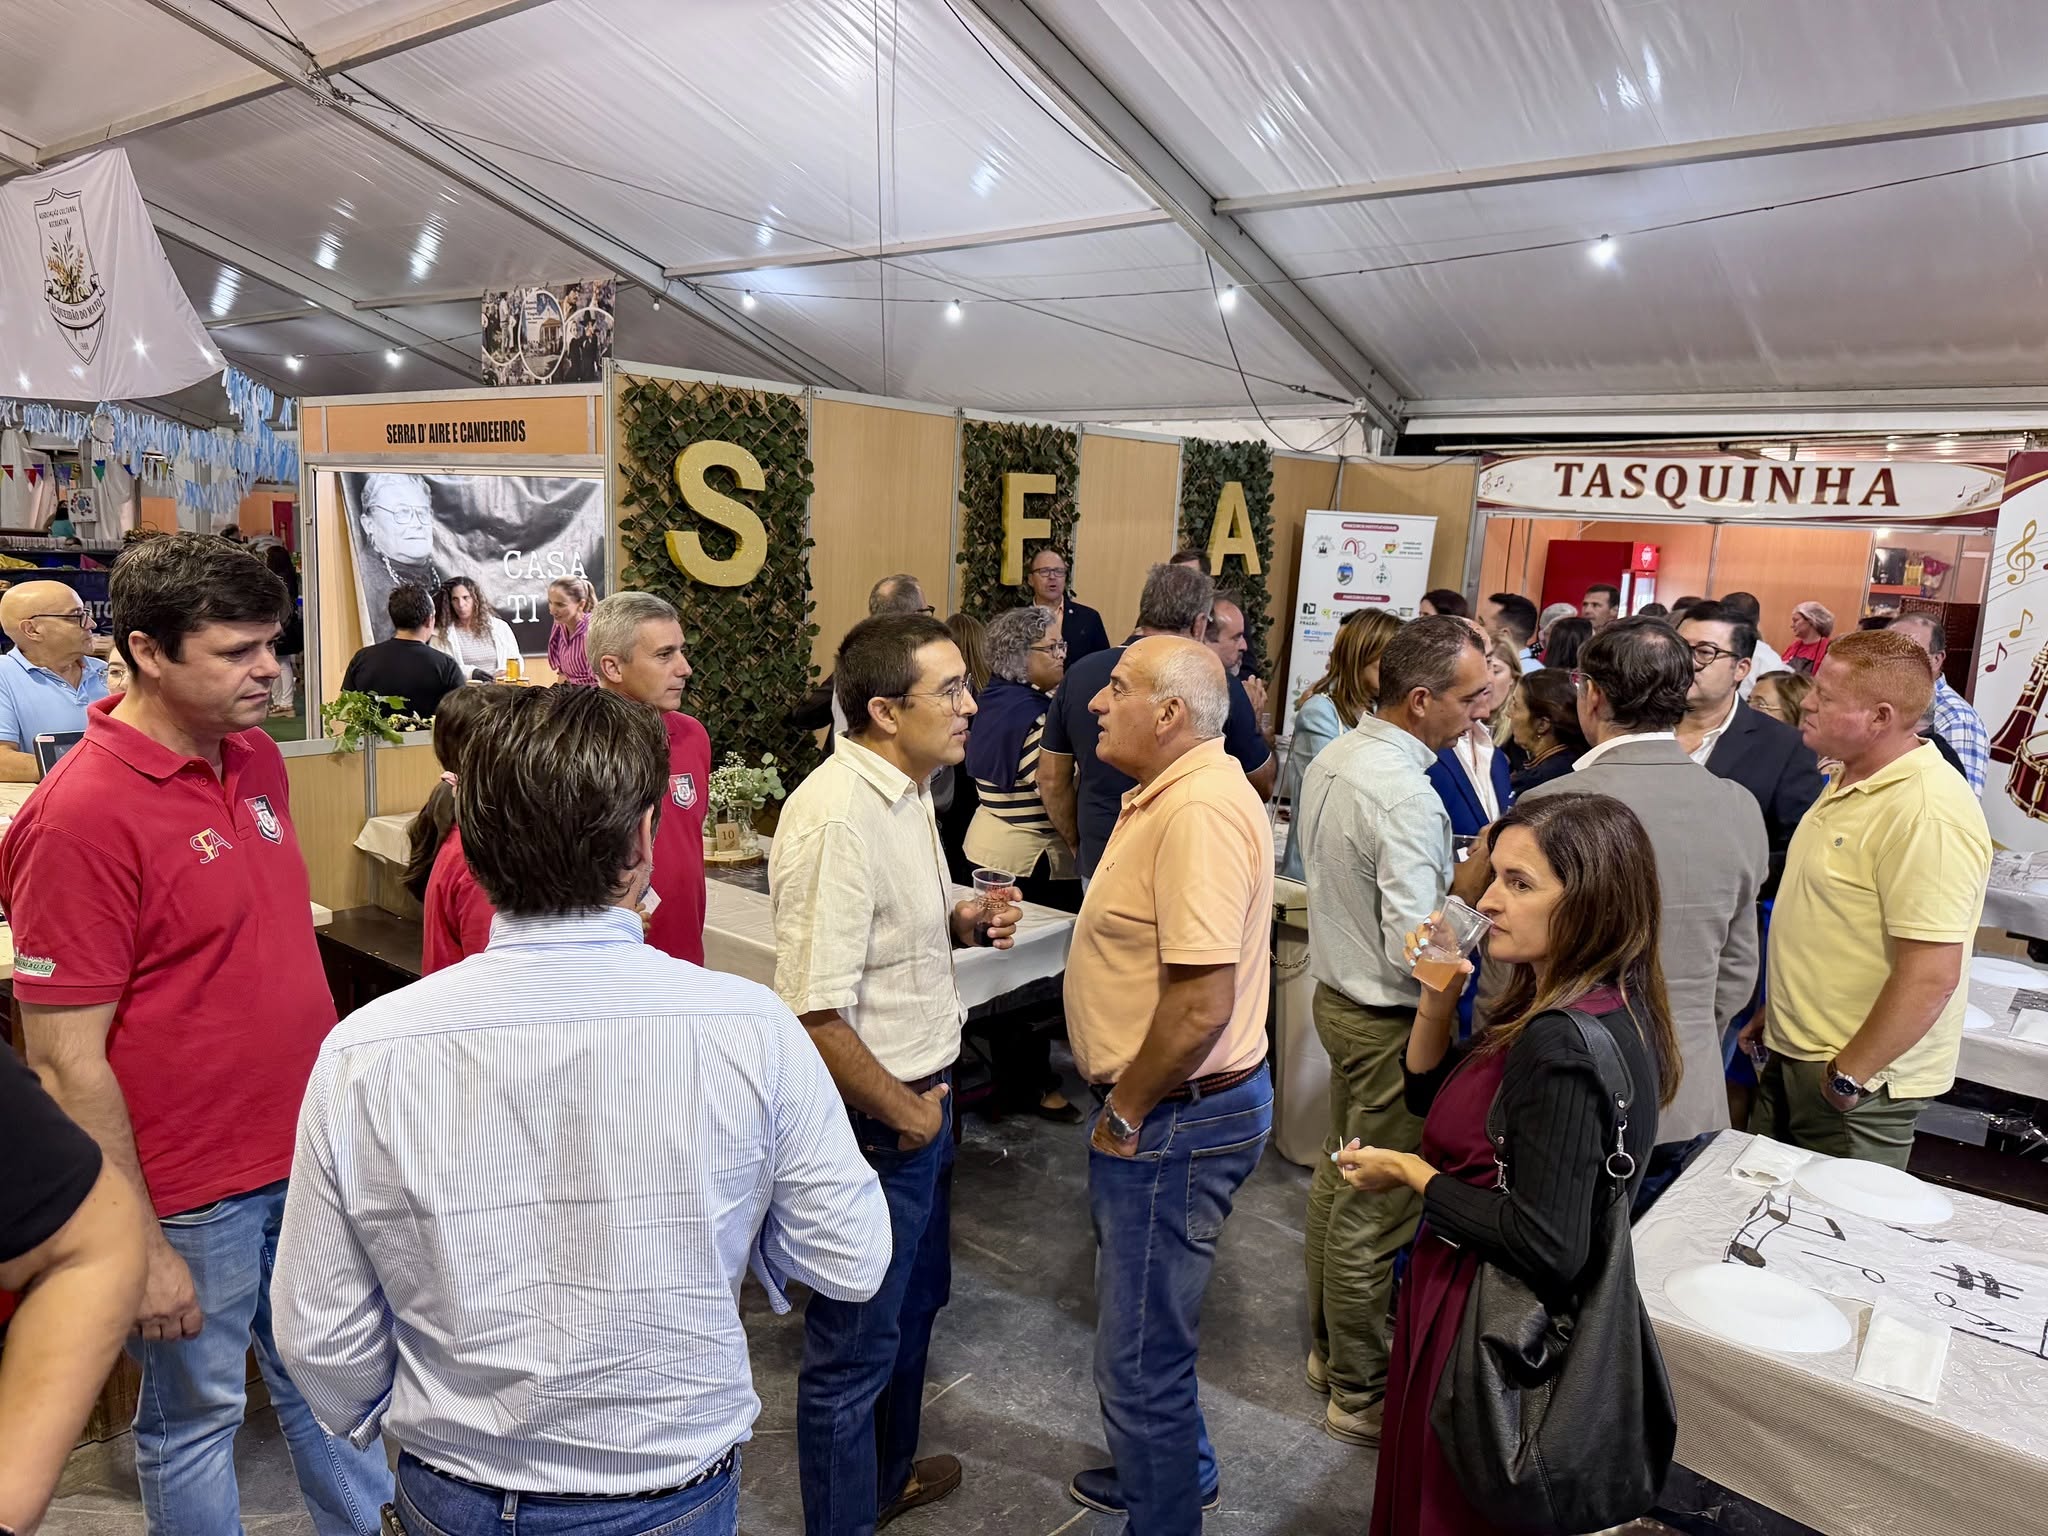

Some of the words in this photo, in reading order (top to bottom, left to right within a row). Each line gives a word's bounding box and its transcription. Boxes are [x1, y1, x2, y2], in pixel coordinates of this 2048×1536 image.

[51, 303, 80, 321] ALQUEIDÃO
[80, 308, 88, 320] DO
[87, 298, 101, 316] MATO
[386, 423, 417, 444] SERRA
[428, 422, 451, 444] AIRE
[453, 422, 458, 443] E
[460, 419, 526, 443] CANDEEIROS
[1553, 462, 1901, 510] TASQUINHA
[664, 439, 768, 588] S
[1000, 472, 1057, 586] F
[1207, 480, 1262, 576] A
[503, 550, 588, 580] CASA
[507, 594, 541, 624] TI
[722, 830, 735, 840] 10
